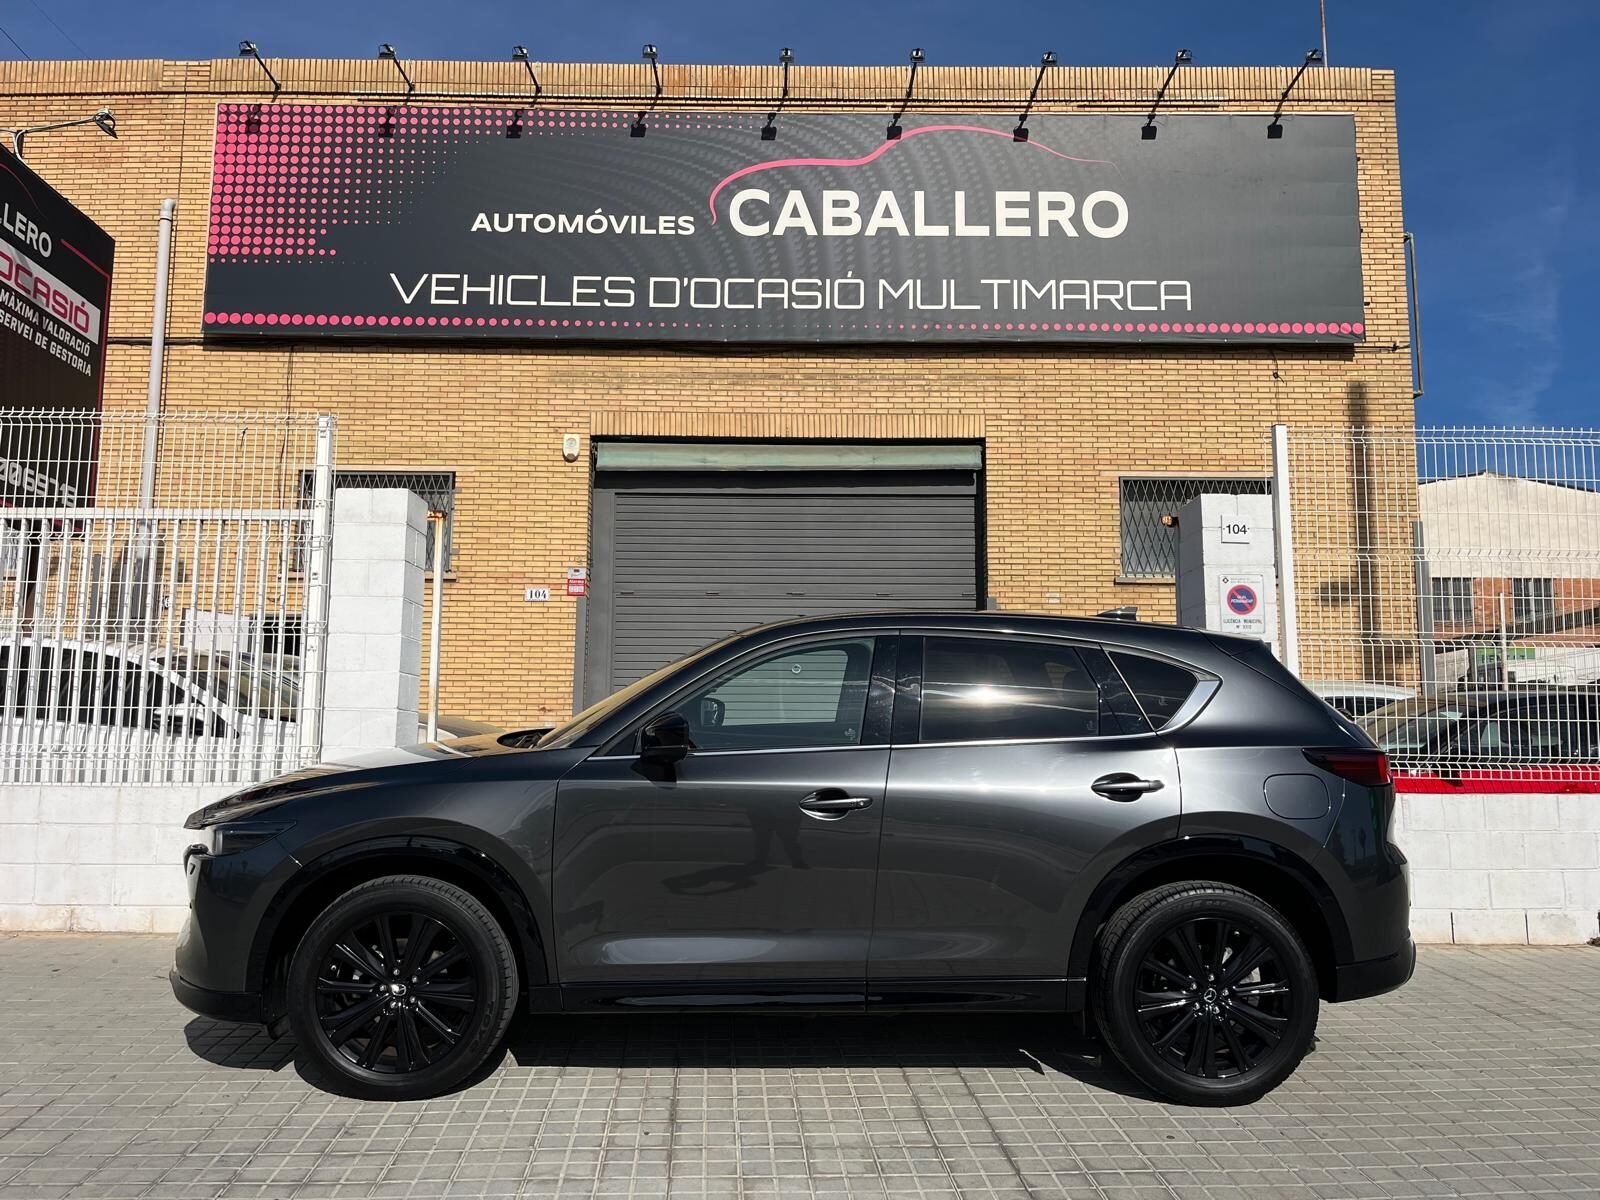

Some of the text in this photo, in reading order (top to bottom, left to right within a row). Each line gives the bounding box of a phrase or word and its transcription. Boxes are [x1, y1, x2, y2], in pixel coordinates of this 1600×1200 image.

[0, 203, 52, 258] LERO
[470, 188, 1129, 239] AUTOMÓVILES CABALLERO
[389, 271, 1192, 311] VEHICLES D'OCASIÓ MULTIMARCA
[0, 310, 91, 377] SERVEI DE GESTORIA
[1, 288, 91, 357] MÀXIMA VALORACIÓ
[1226, 524, 1247, 535] 104
[530, 589, 546, 599] 104
